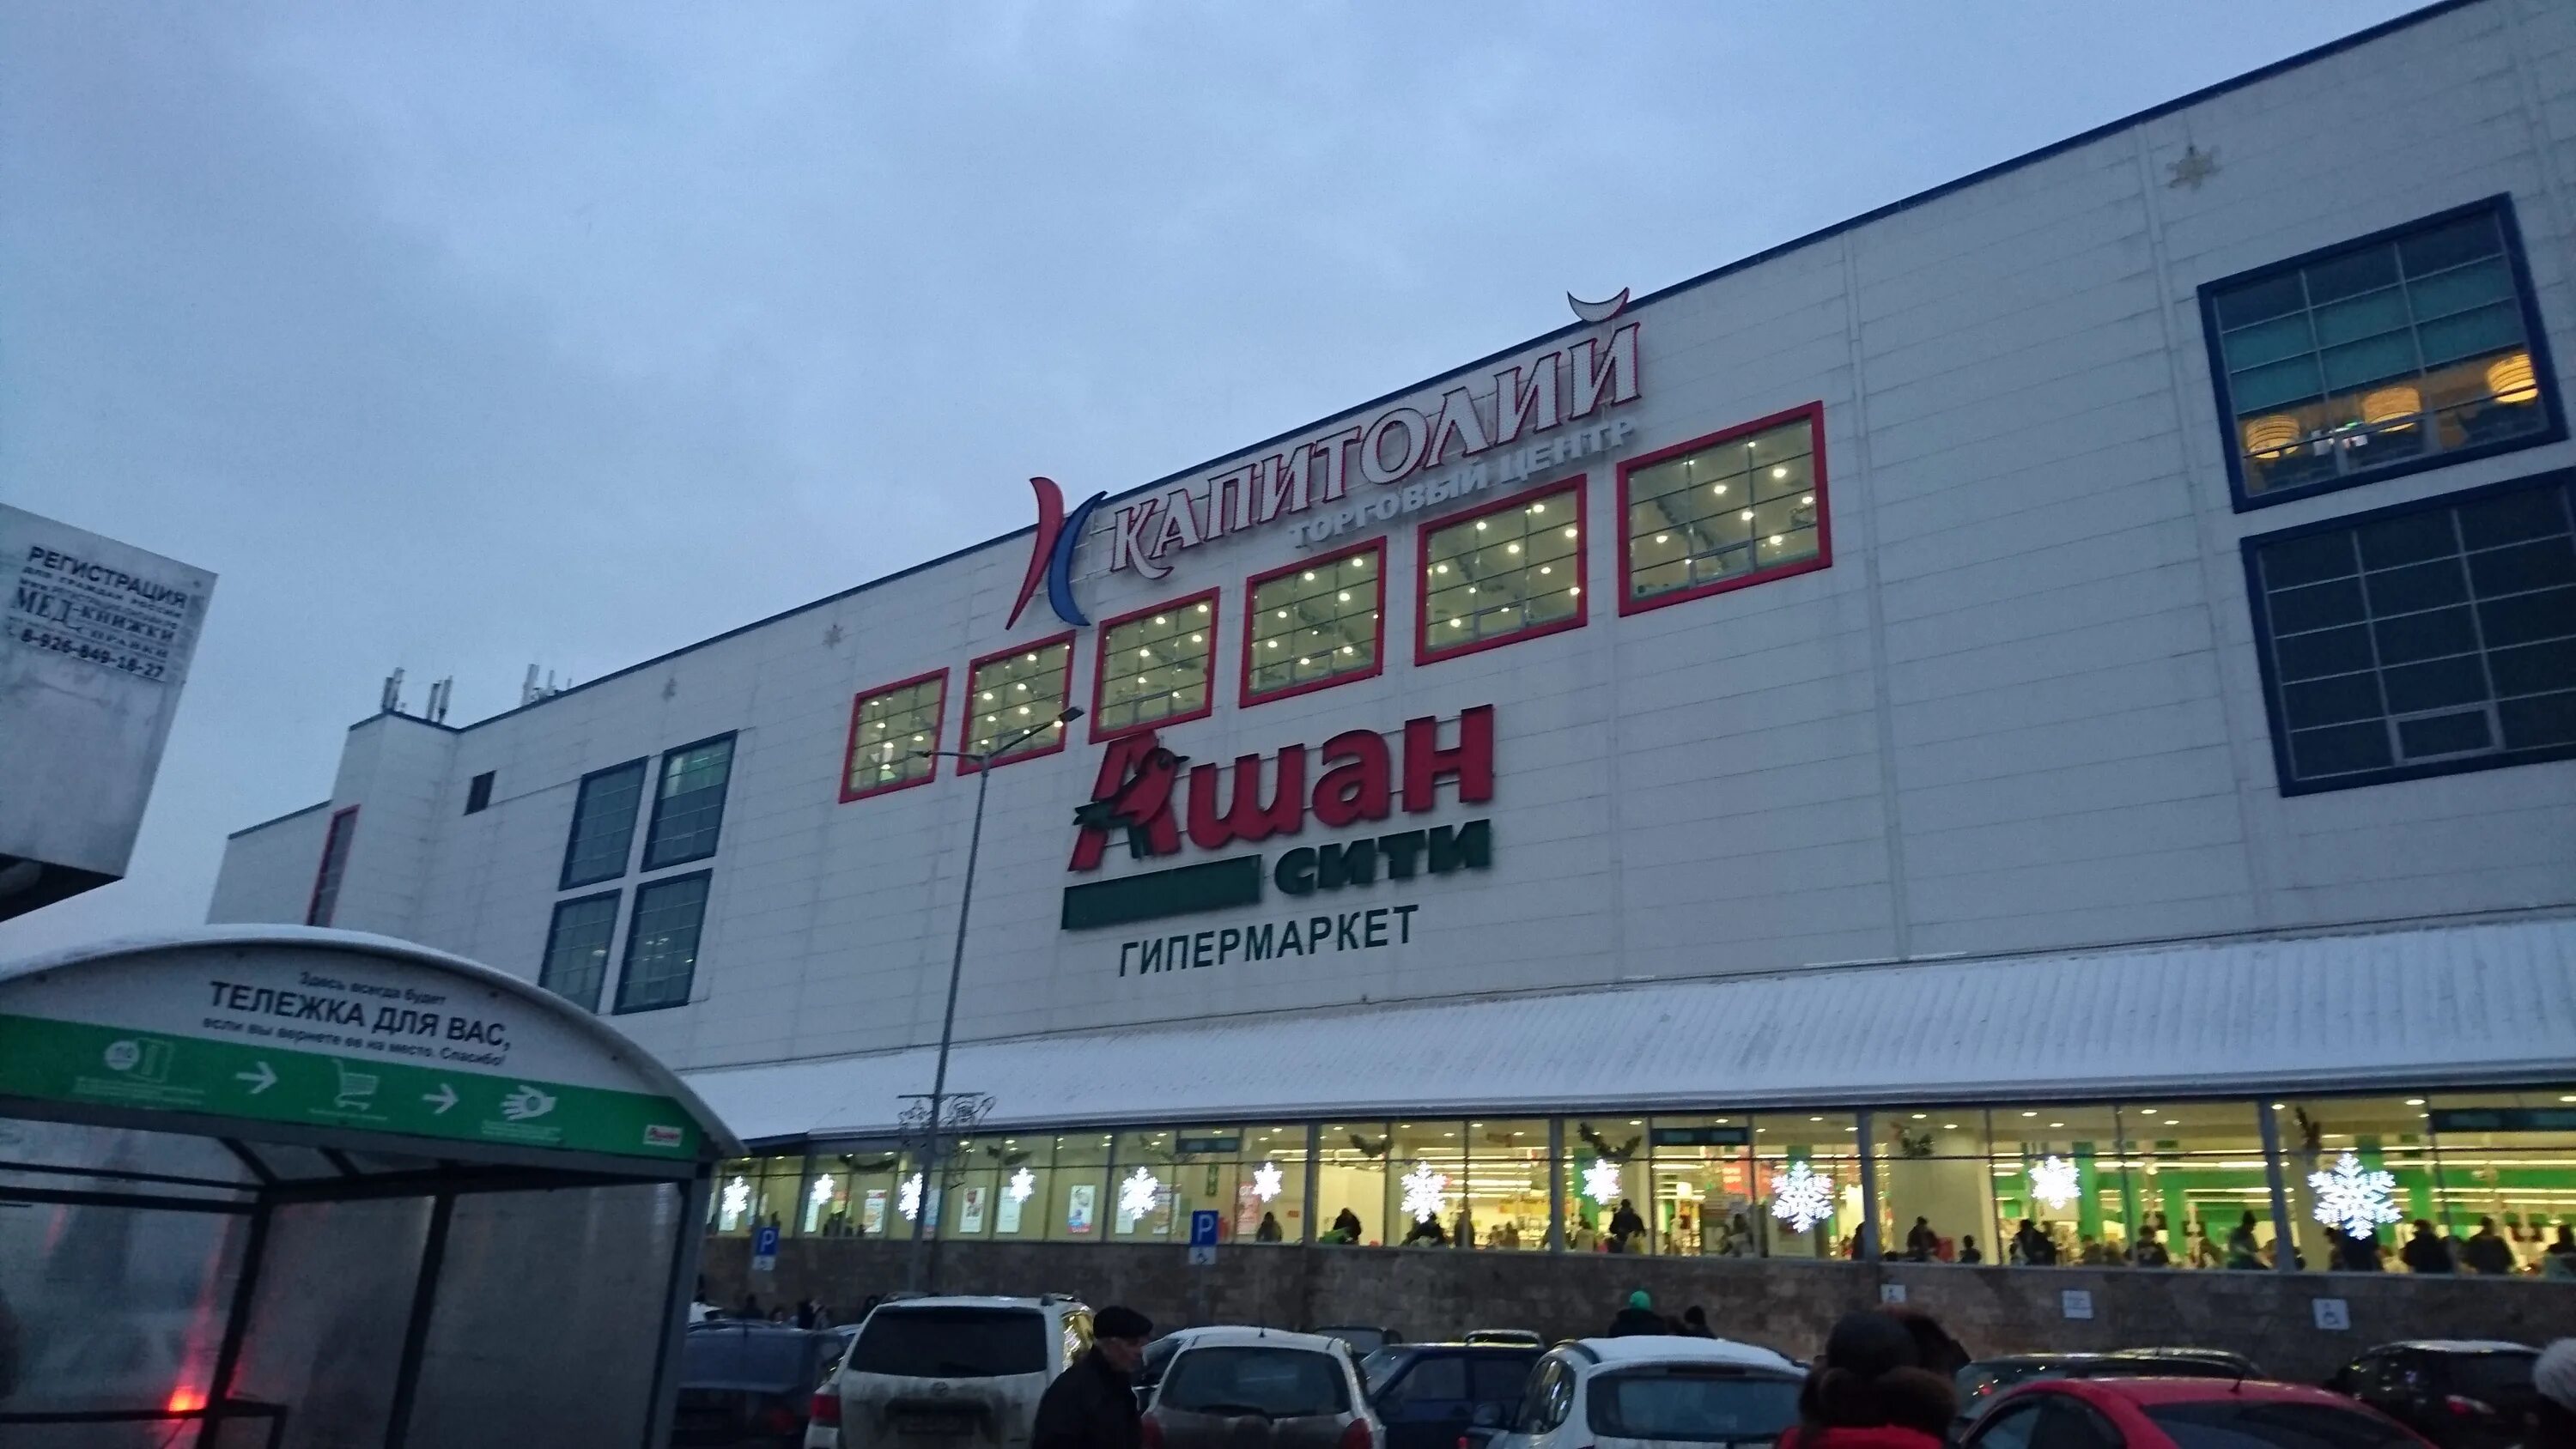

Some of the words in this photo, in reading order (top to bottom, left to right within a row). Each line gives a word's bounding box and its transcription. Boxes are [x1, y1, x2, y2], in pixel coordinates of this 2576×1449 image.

[1110, 287, 1642, 581] КАПИТОЛИЙ
[1290, 456, 1489, 549] ТОРГОВЫЙ
[1500, 418, 1632, 483] ЦЕНТР
[27, 545, 188, 609] РЕГИСТРАЦИЯ
[1119, 904, 1419, 978] ГИПЕРМАРКЕТ
[210, 979, 365, 1028] ТЕЛЕЖКА
[371, 1006, 440, 1038] ДЛЯ
[447, 1016, 512, 1052] ВАС,
[1197, 1214, 1215, 1243] P
